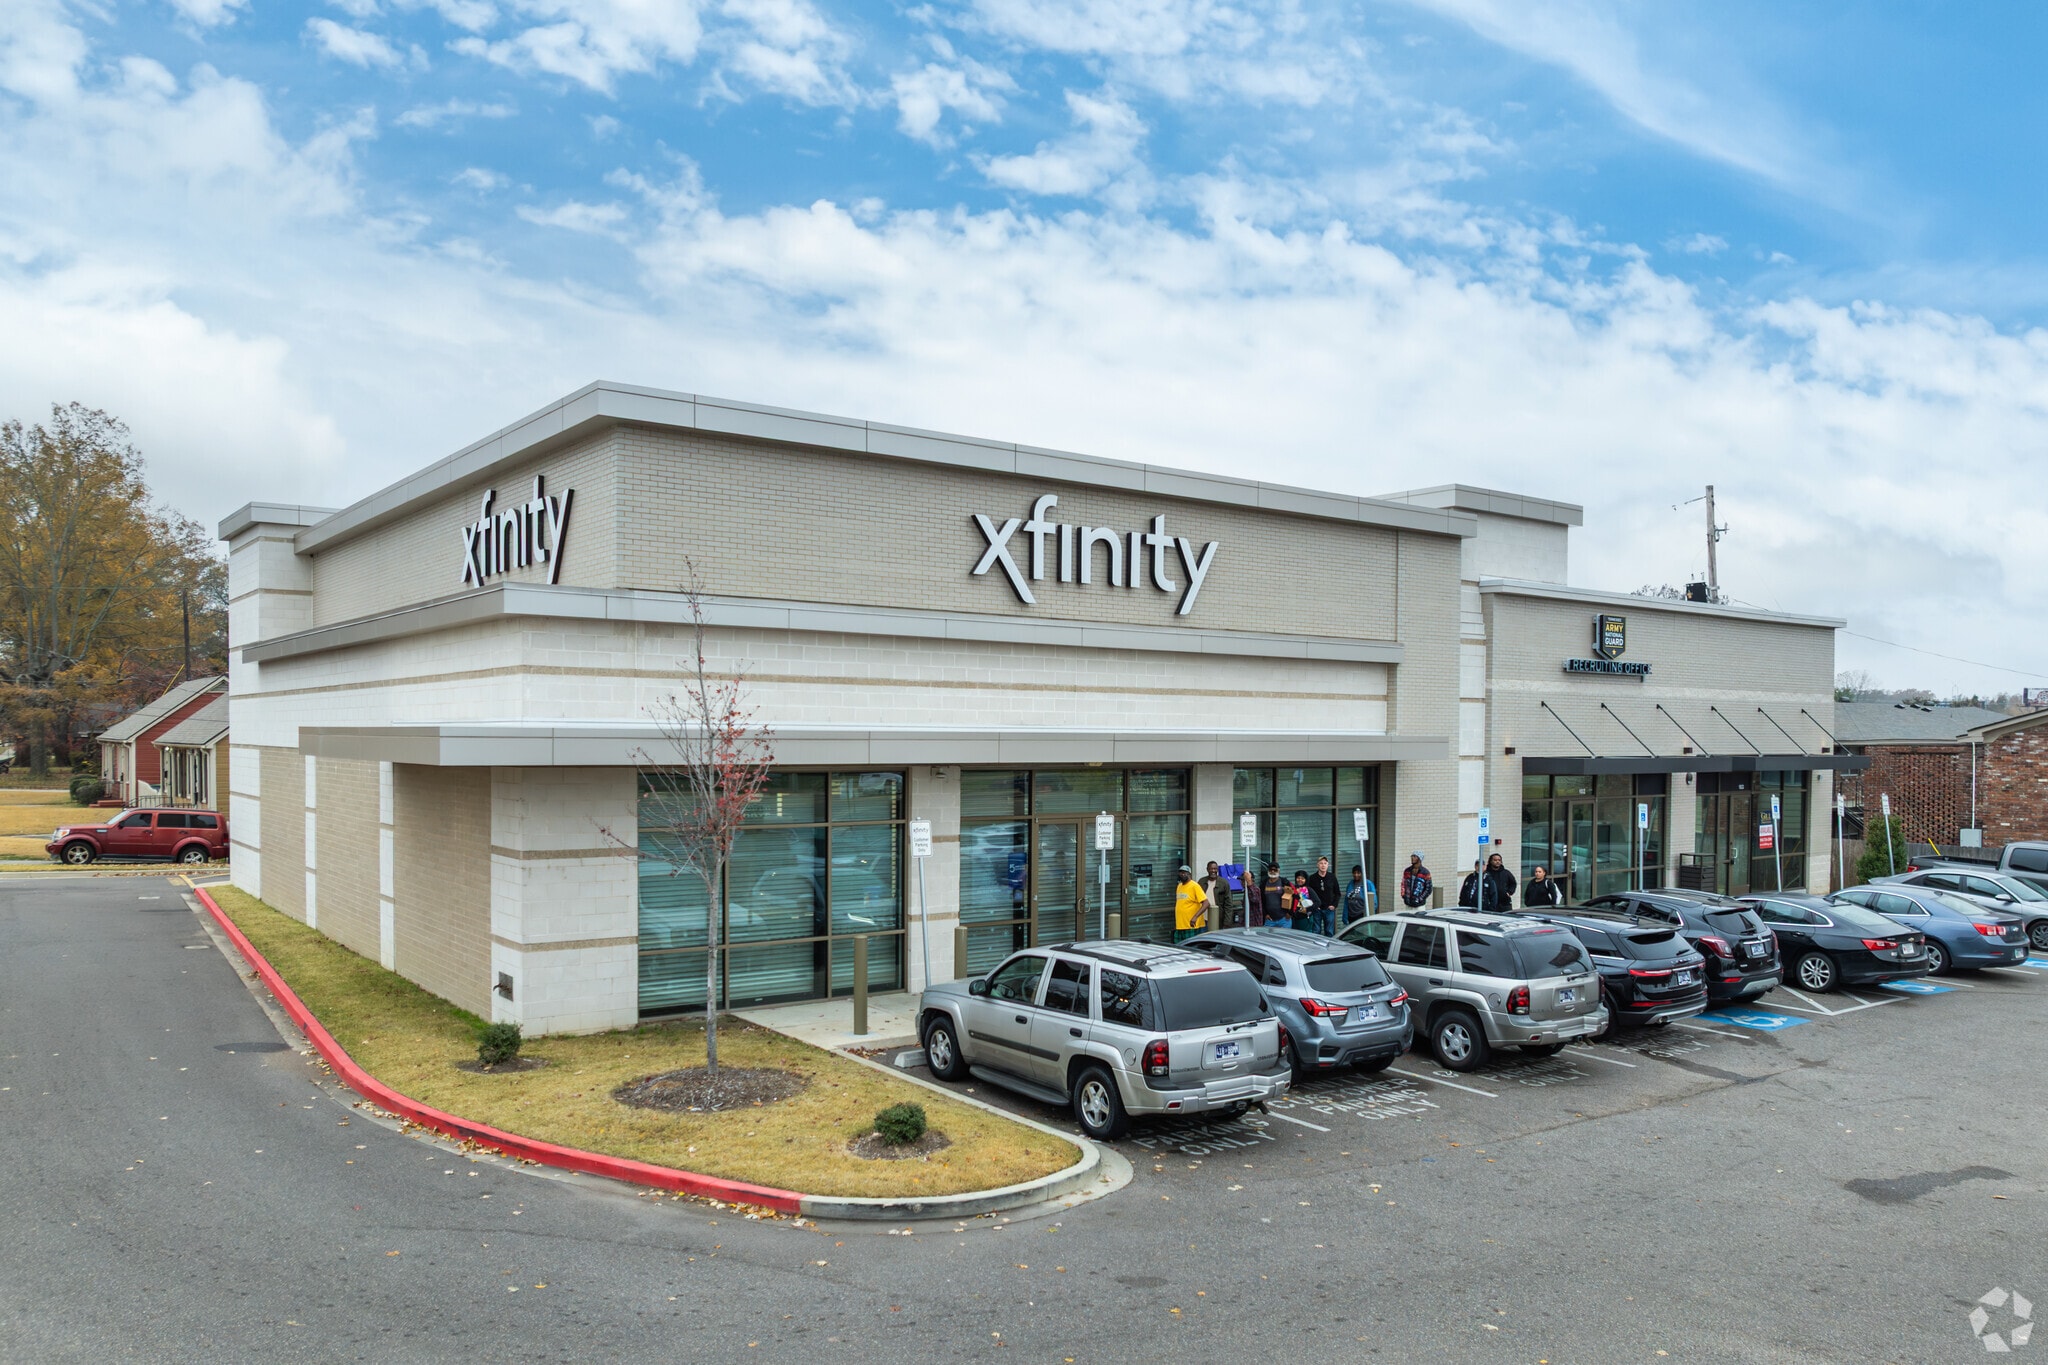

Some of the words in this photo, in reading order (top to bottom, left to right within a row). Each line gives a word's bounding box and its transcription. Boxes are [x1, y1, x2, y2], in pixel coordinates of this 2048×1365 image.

[461, 475, 574, 588] xfinity
[969, 494, 1219, 615] xfinity
[1605, 623, 1623, 632] ARMY
[1605, 638, 1623, 646] GUARD
[1573, 659, 1623, 673] RECRUITING
[1625, 662, 1652, 675] OFFICE
[1519, 1068, 1590, 1087] ONLY
[1267, 1078, 1419, 1110] CUSTOMER
[1310, 1089, 1428, 1115] PARKING
[1356, 1099, 1440, 1120] ONLY
[1132, 1118, 1269, 1149] PARKING
[1180, 1131, 1276, 1155] ONLY
